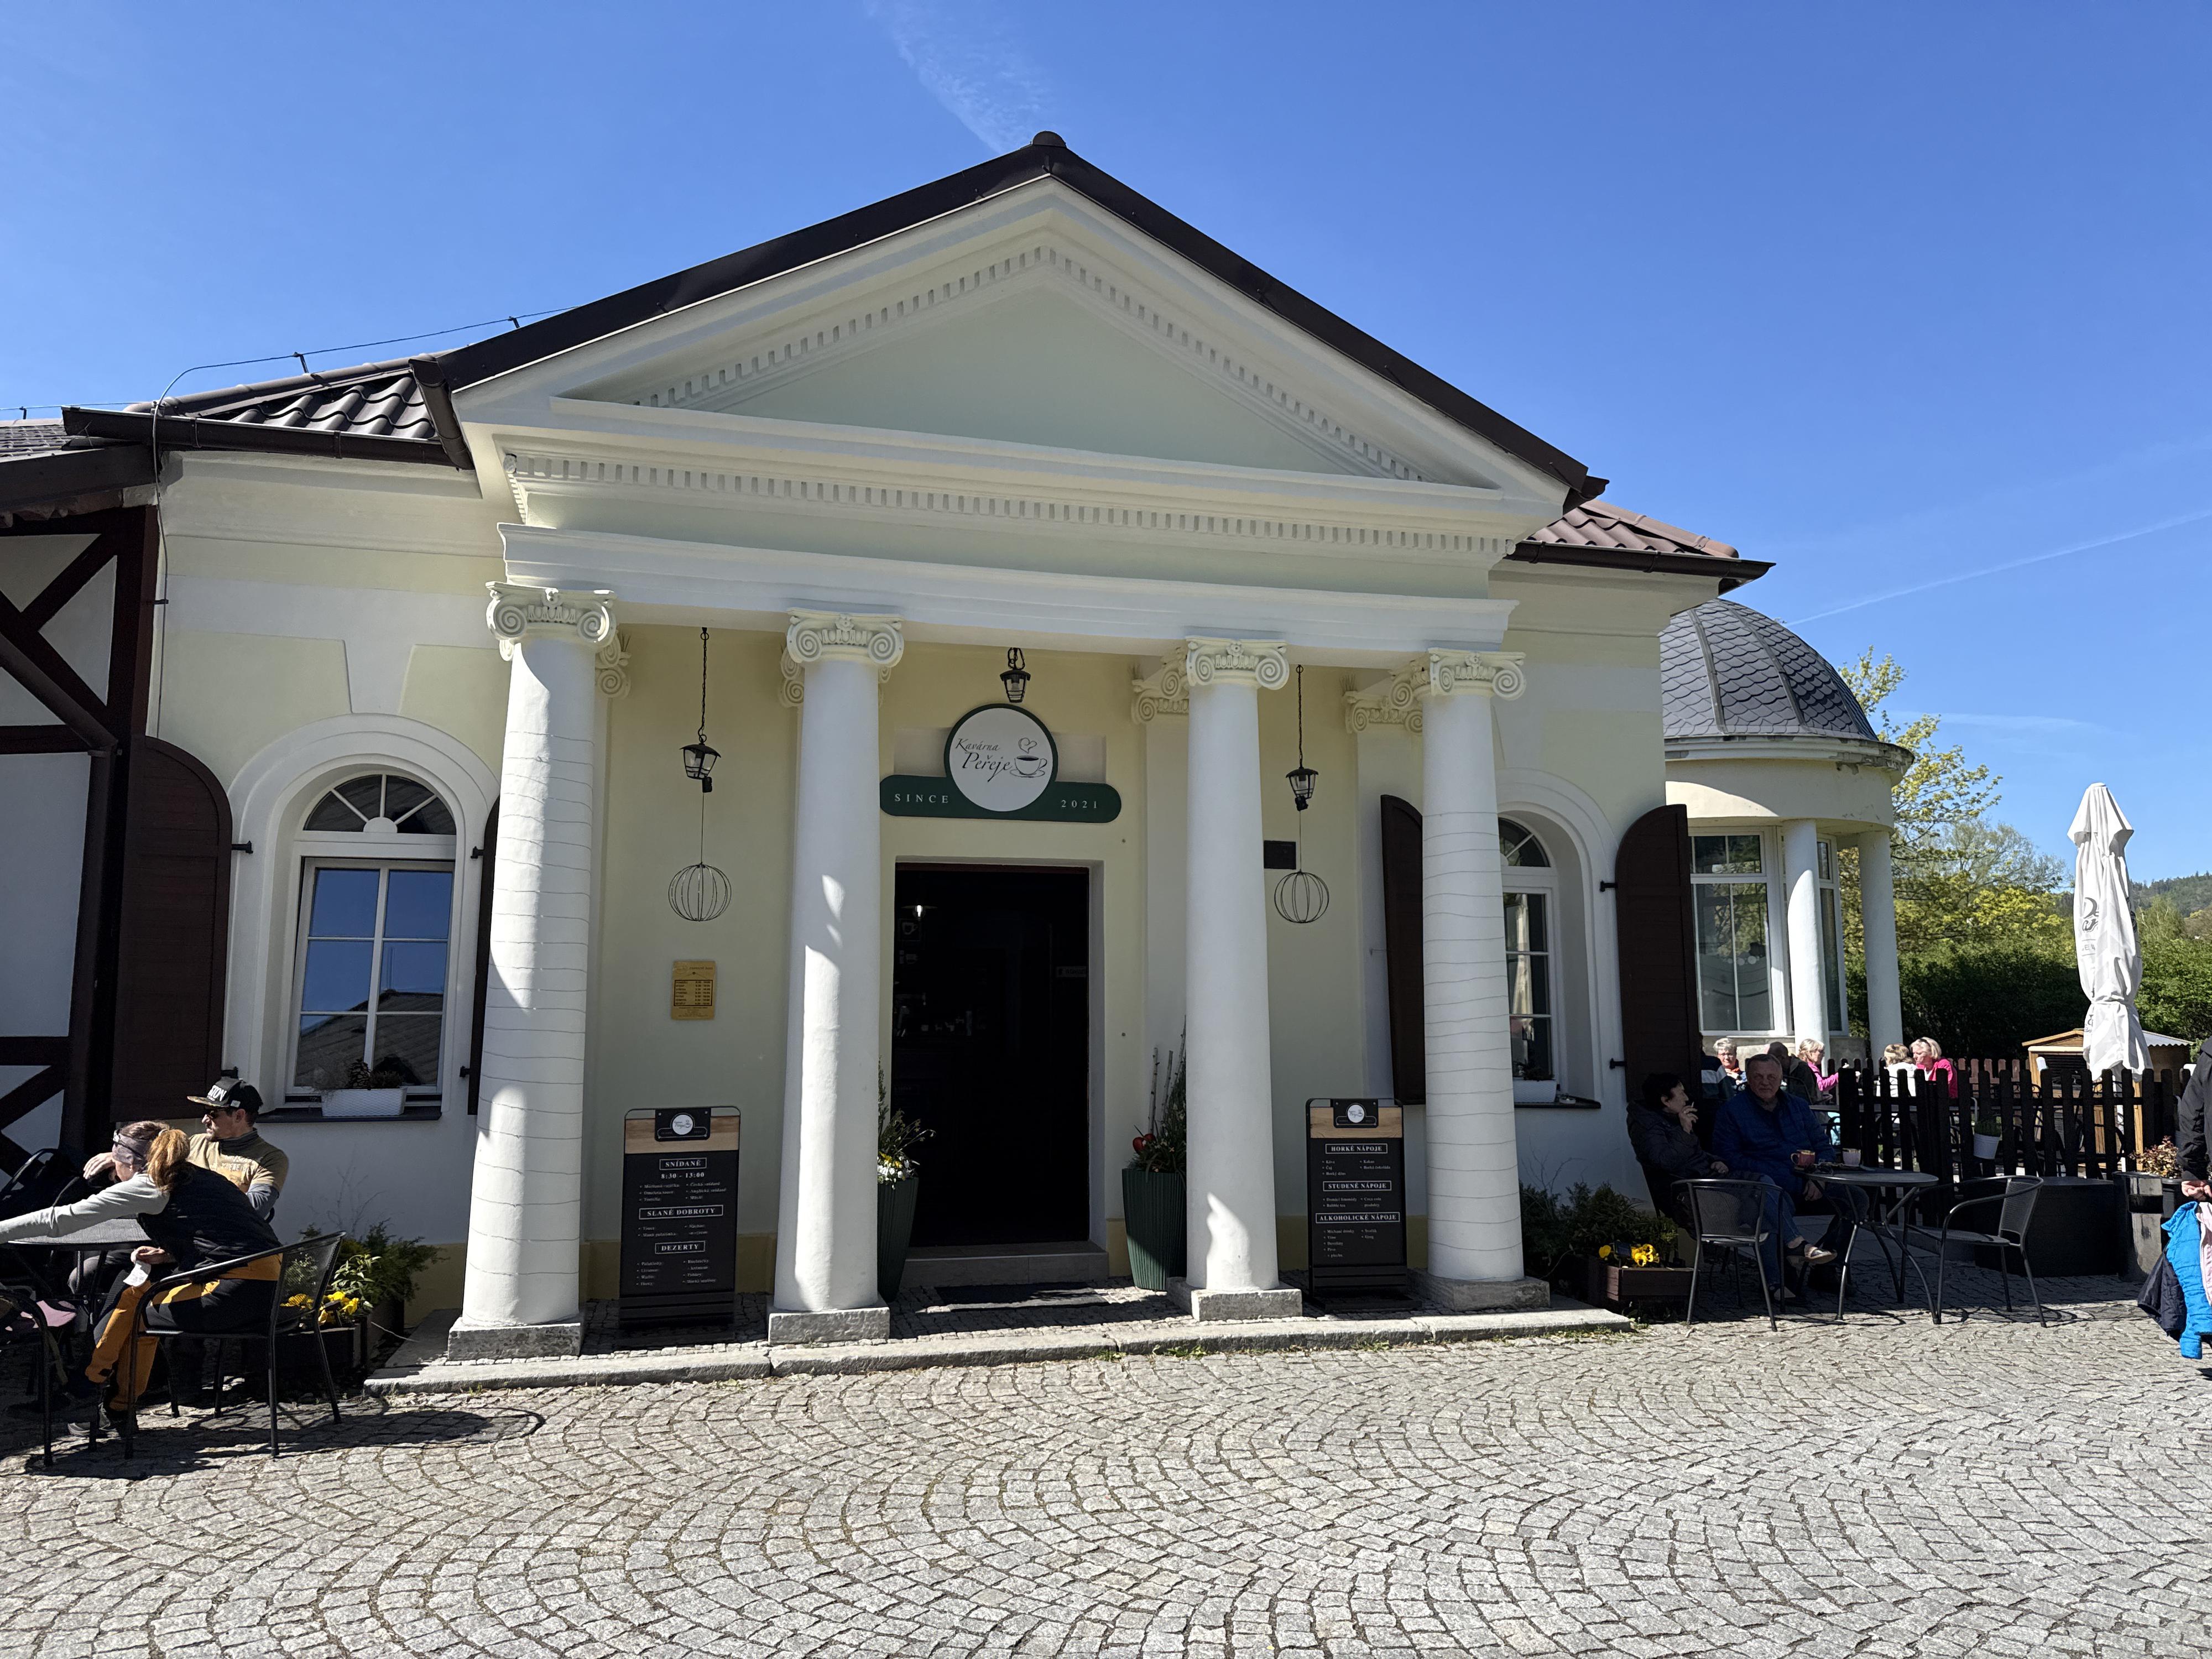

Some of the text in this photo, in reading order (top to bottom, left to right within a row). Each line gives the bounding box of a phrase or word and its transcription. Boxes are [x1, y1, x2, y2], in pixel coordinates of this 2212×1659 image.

[954, 738, 1000, 752] Kavárna
[962, 752, 1013, 782] Peřeje
[894, 794, 1098, 809] SINCE 2021
[647, 1208, 674, 1217] SLANÉ
